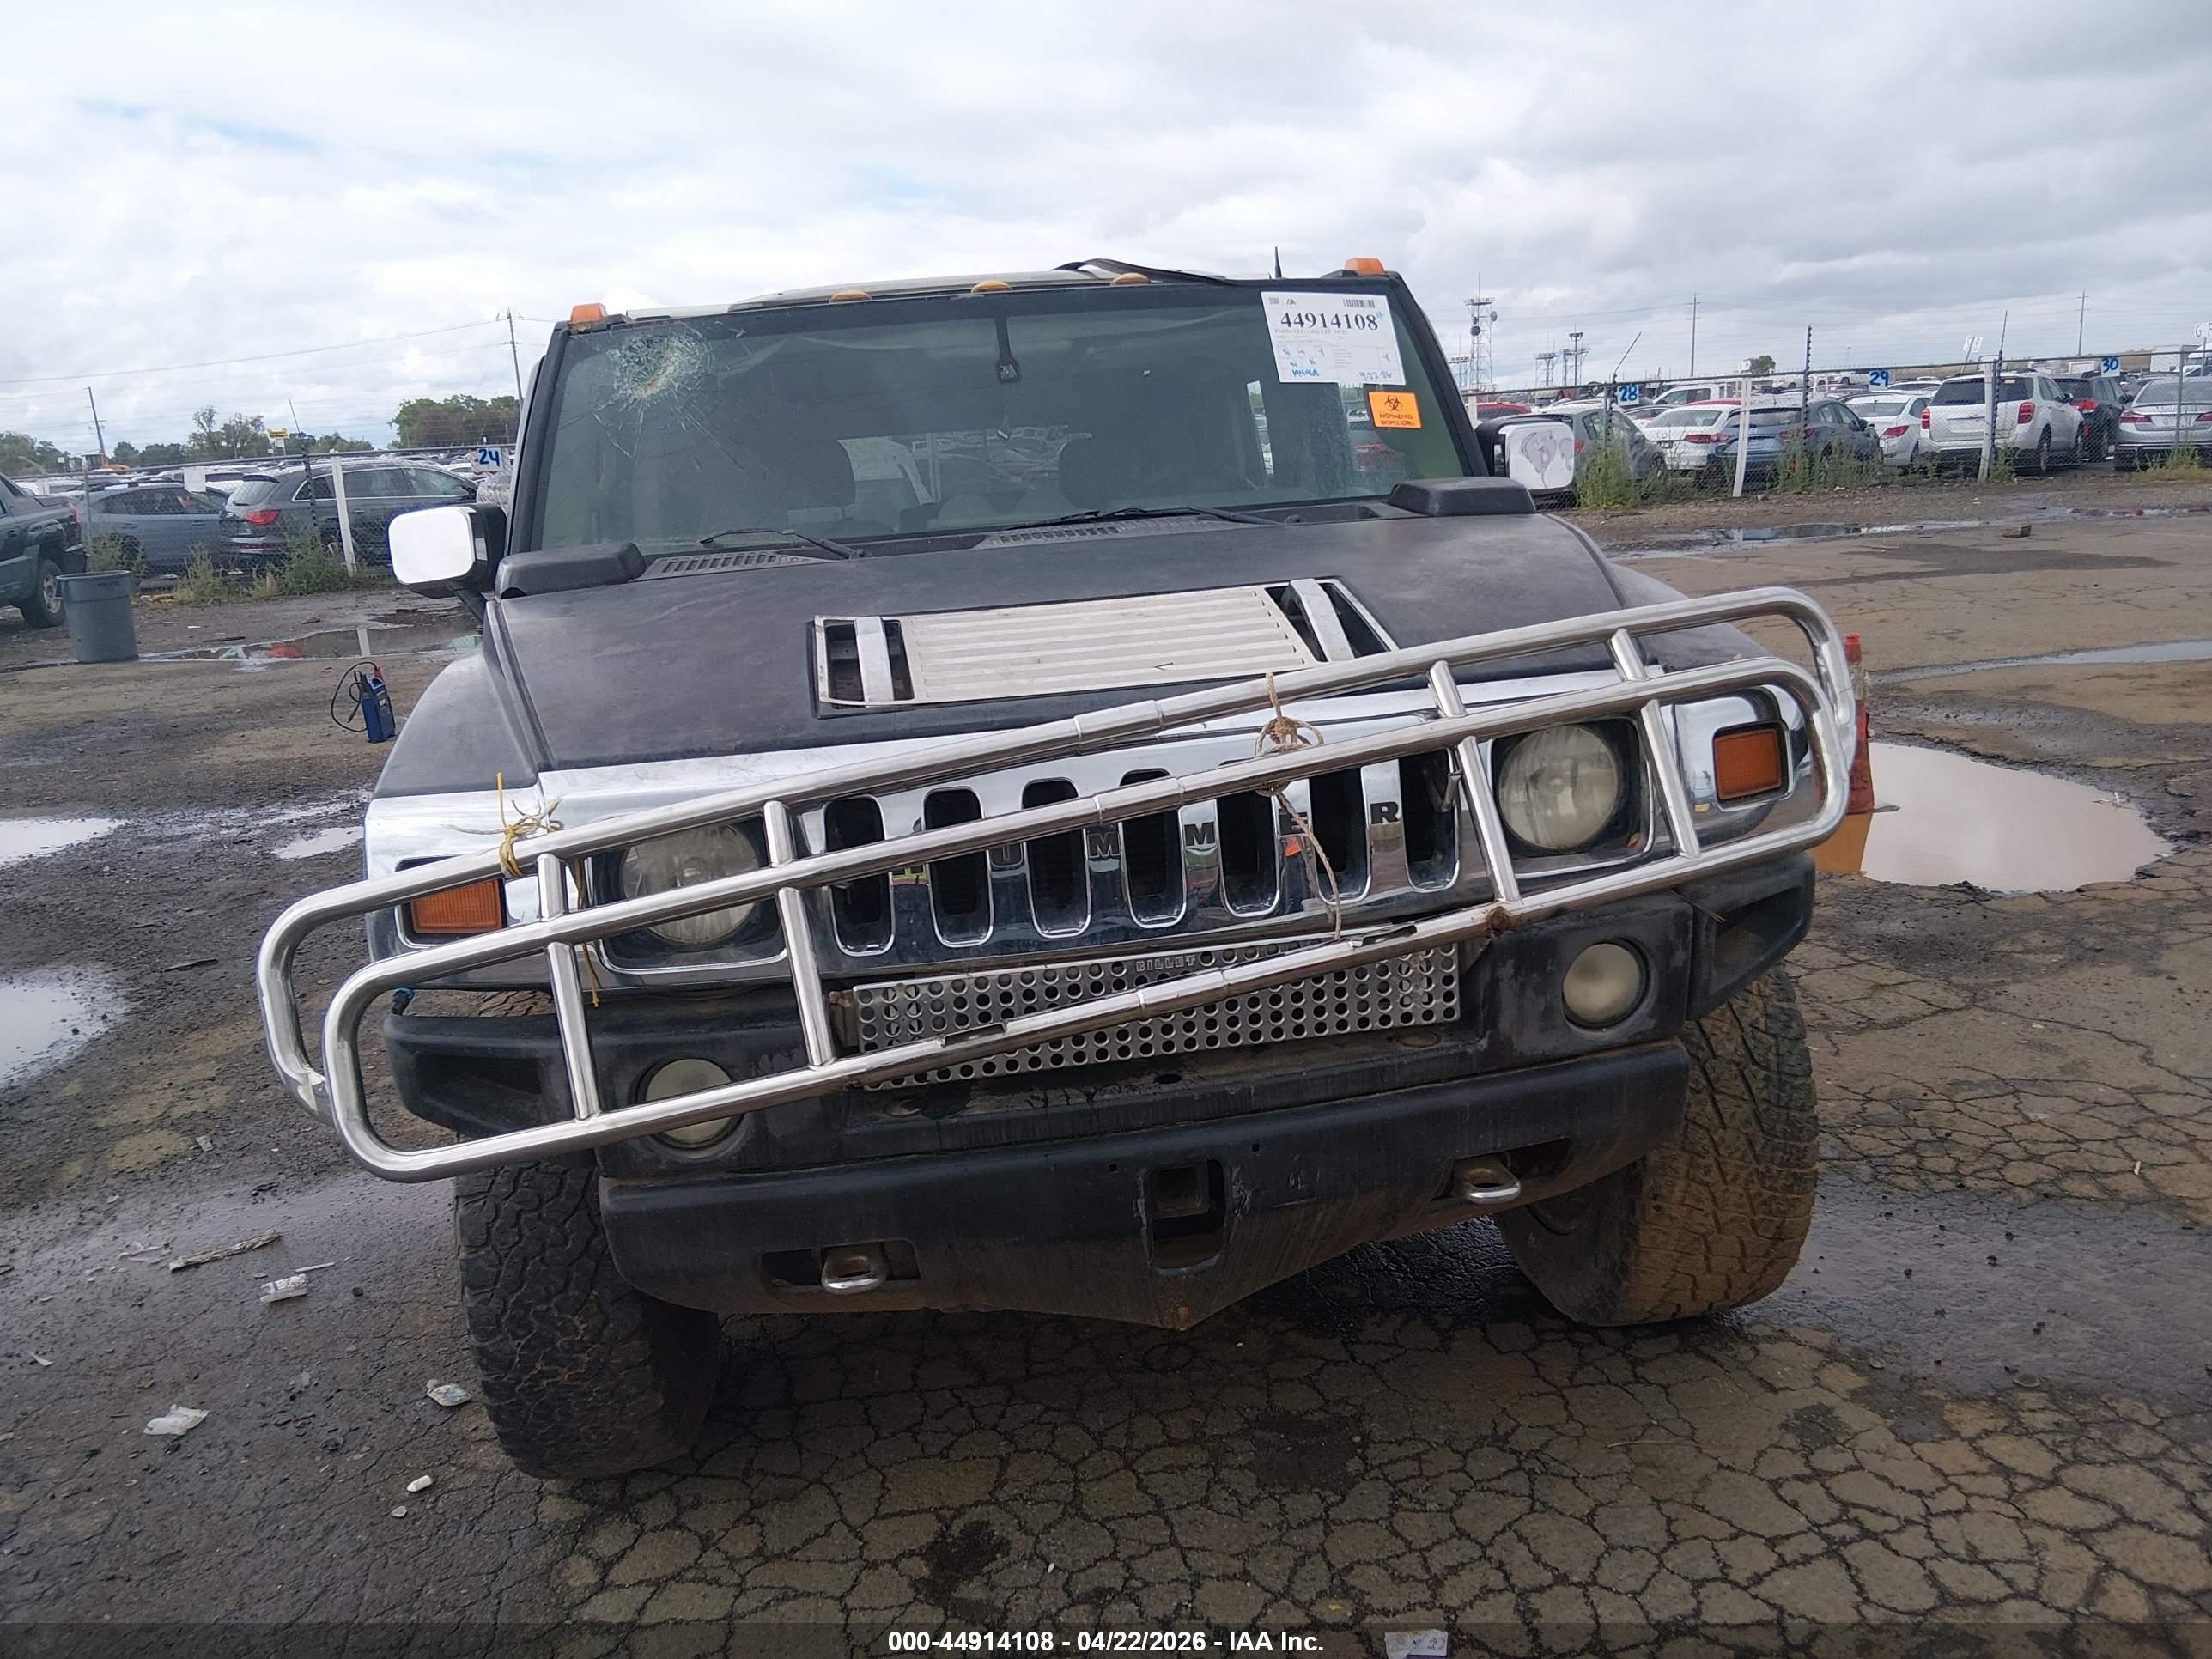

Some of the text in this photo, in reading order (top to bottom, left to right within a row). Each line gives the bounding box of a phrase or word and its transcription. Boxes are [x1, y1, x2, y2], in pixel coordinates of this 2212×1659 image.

[1280, 312, 1379, 331] 44914108
[2101, 356, 2119, 373] 30
[1869, 370, 1889, 387] 29
[1619, 384, 1638, 402] 28
[478, 448, 500, 467] 24
[1136, 955, 1196, 972] BILLET
